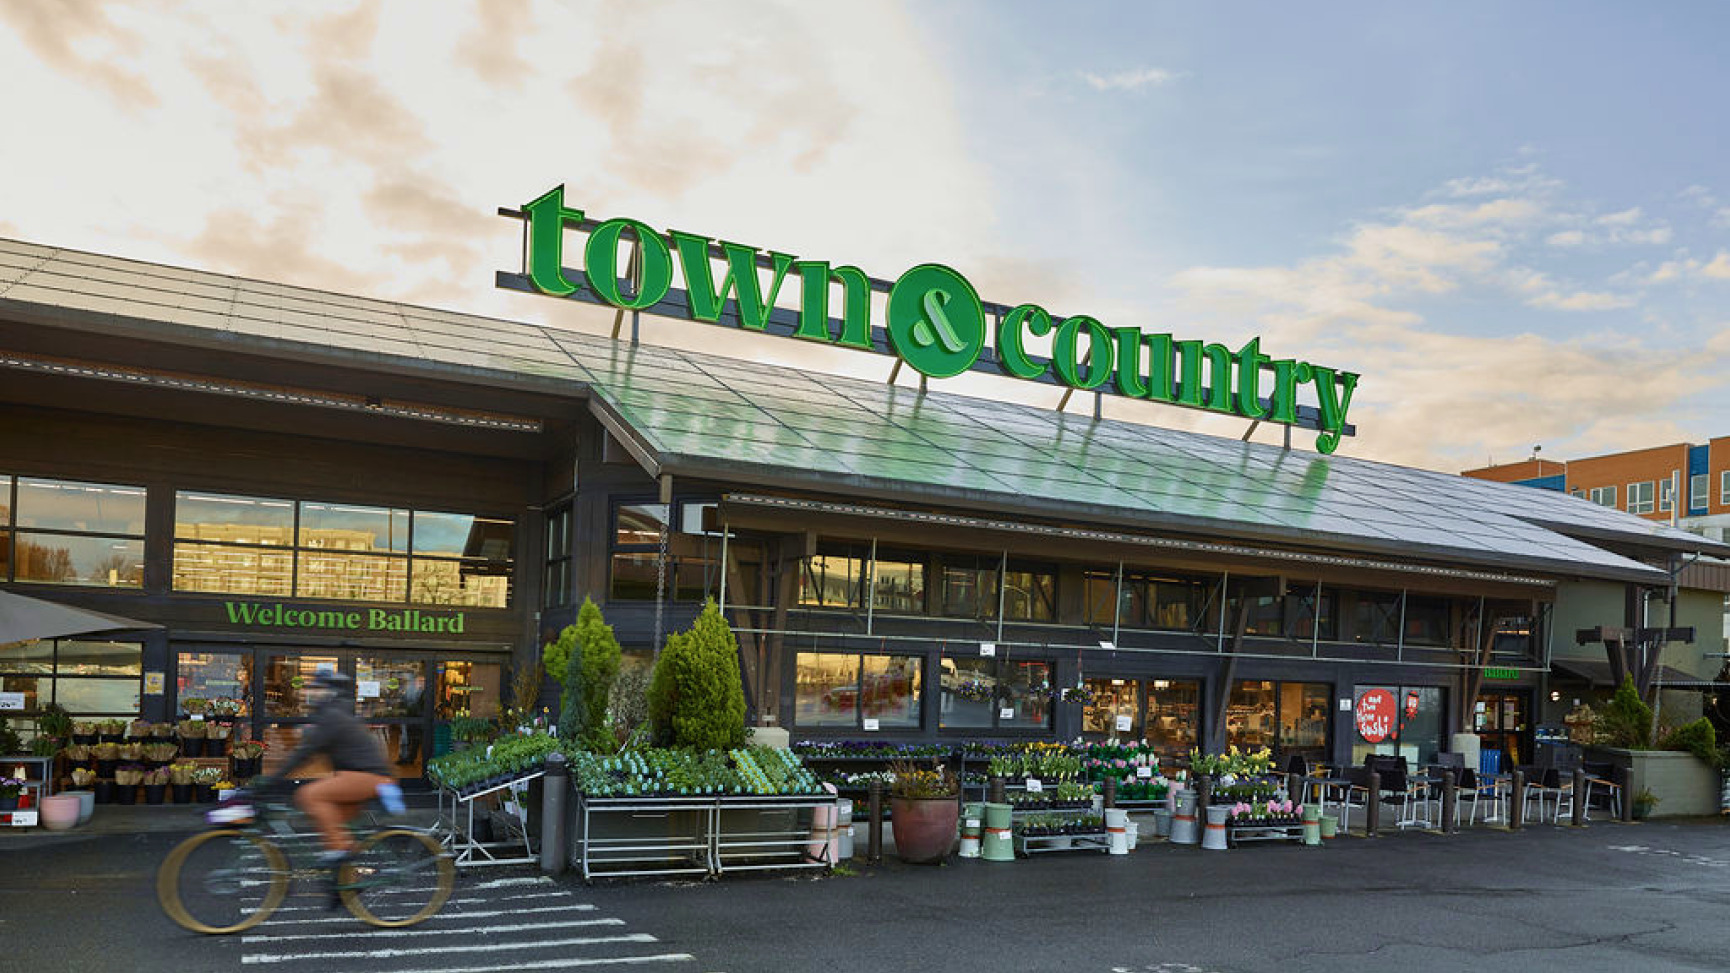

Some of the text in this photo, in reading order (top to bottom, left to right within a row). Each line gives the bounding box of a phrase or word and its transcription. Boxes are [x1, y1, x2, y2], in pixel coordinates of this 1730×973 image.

[521, 184, 873, 350] town
[999, 302, 1361, 455] country
[225, 602, 465, 634] Welcome Ballard
[1360, 714, 1389, 738] sushi
